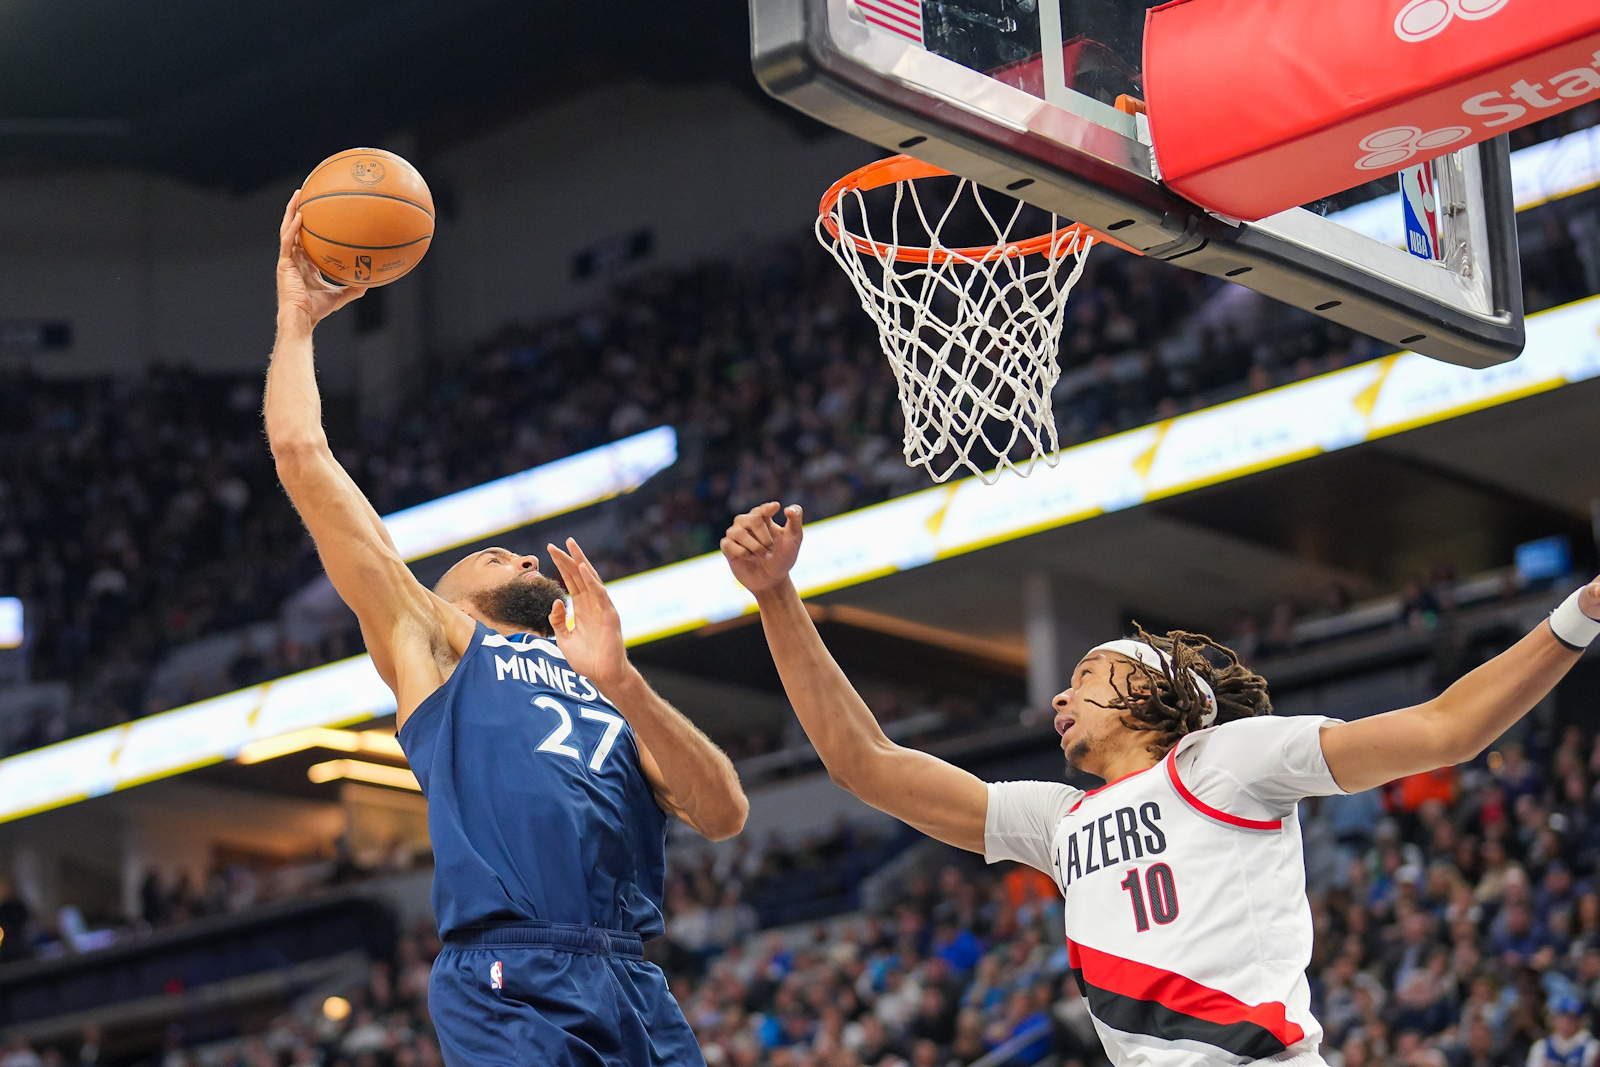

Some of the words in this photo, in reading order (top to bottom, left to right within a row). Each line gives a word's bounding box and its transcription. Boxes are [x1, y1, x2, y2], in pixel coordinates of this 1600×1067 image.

[1461, 50, 1600, 128] Sta
[1409, 229, 1429, 257] NBA
[494, 654, 613, 705] MINNES
[531, 694, 626, 773] 27
[1120, 862, 1180, 933] 10
